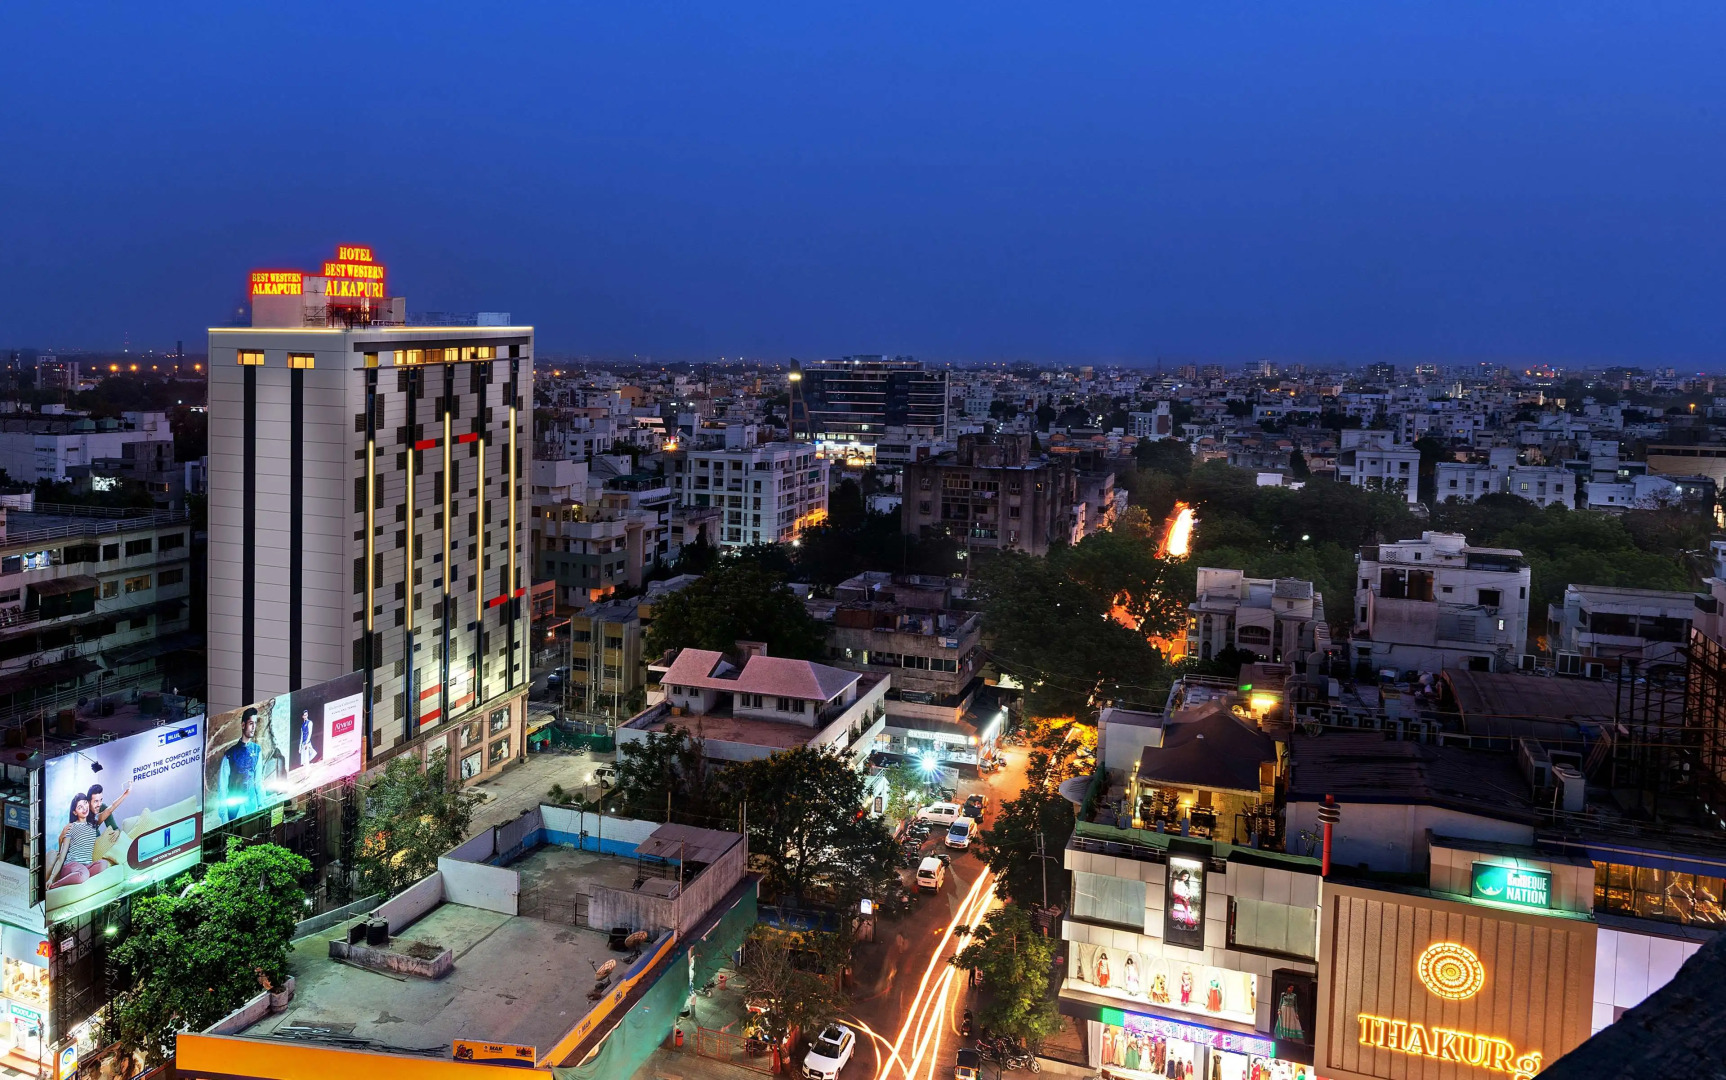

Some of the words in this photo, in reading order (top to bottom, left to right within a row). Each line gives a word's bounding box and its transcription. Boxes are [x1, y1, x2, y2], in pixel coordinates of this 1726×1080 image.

[339, 246, 373, 261] HOTEL
[252, 273, 269, 282] BEST
[270, 273, 301, 283] WESTERN
[325, 263, 347, 277] BEST
[347, 264, 384, 279] WESTERN
[252, 283, 302, 295] ALKAPURI
[325, 280, 384, 298] ALKAPURI
[132, 762, 151, 774] ENJOY
[152, 759, 163, 768] THE
[165, 749, 192, 764] COMFORT
[192, 746, 201, 754] OF
[133, 765, 169, 782] PRECISION
[171, 754, 200, 770] COOLING
[1506, 886, 1547, 905] NATION
